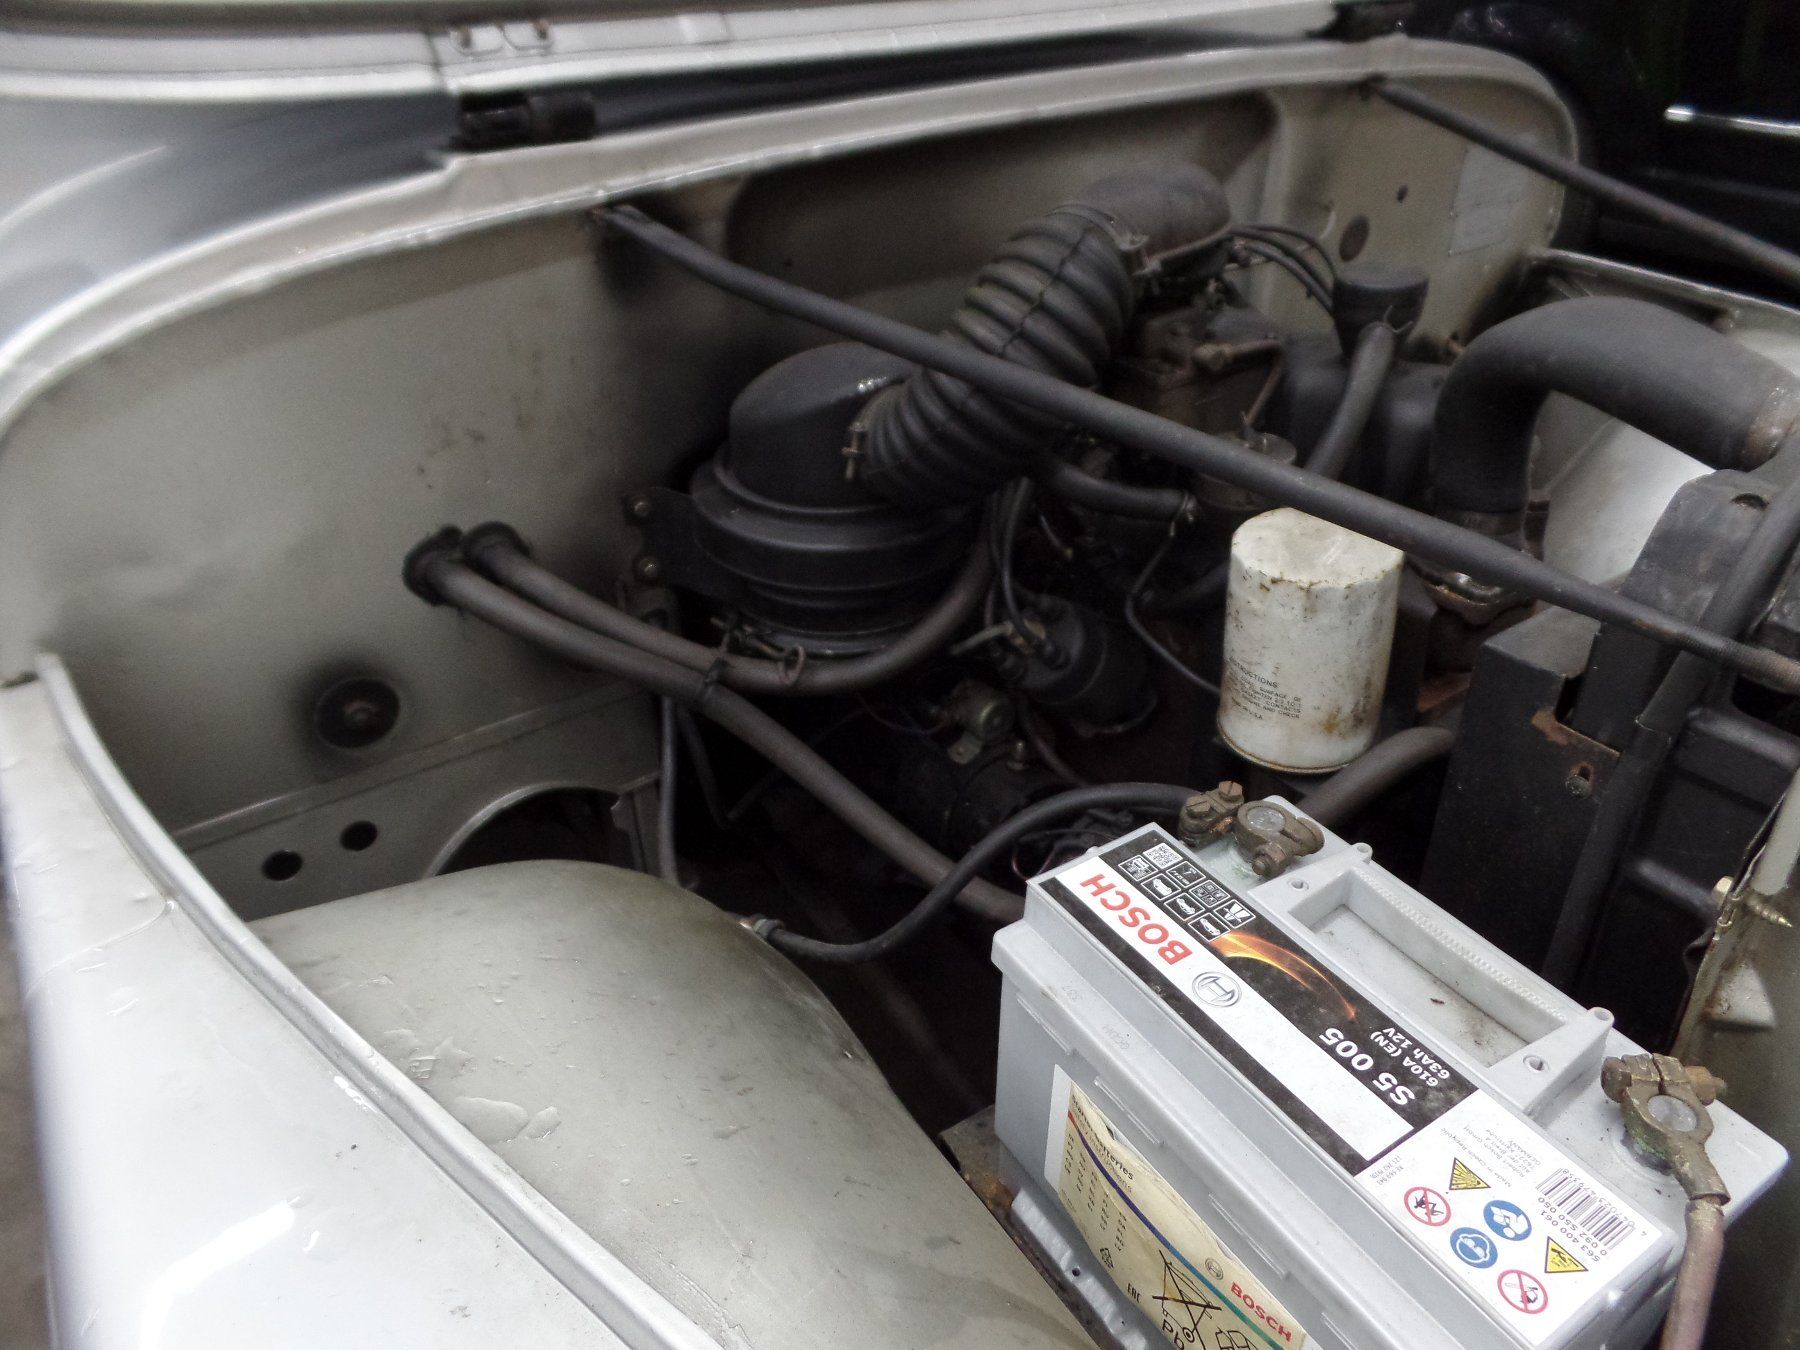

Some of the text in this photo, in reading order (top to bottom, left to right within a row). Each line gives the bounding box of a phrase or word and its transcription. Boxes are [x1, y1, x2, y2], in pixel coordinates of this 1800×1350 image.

[1080, 873, 1193, 965] BOSCH
[1318, 1027, 1416, 1106] S5 005
[1370, 1031, 1438, 1087] 610A (EN)
[1383, 1027, 1450, 1079] 63Ah 12V
[1536, 1195, 1557, 1213] 050
[1538, 1209, 1601, 1262] 563 400 061
[1577, 1230, 1599, 1248] 092
[1599, 1248, 1608, 1256] 0
[1162, 1318, 1185, 1350] Pb
[1231, 1282, 1292, 1342] BOSCH
